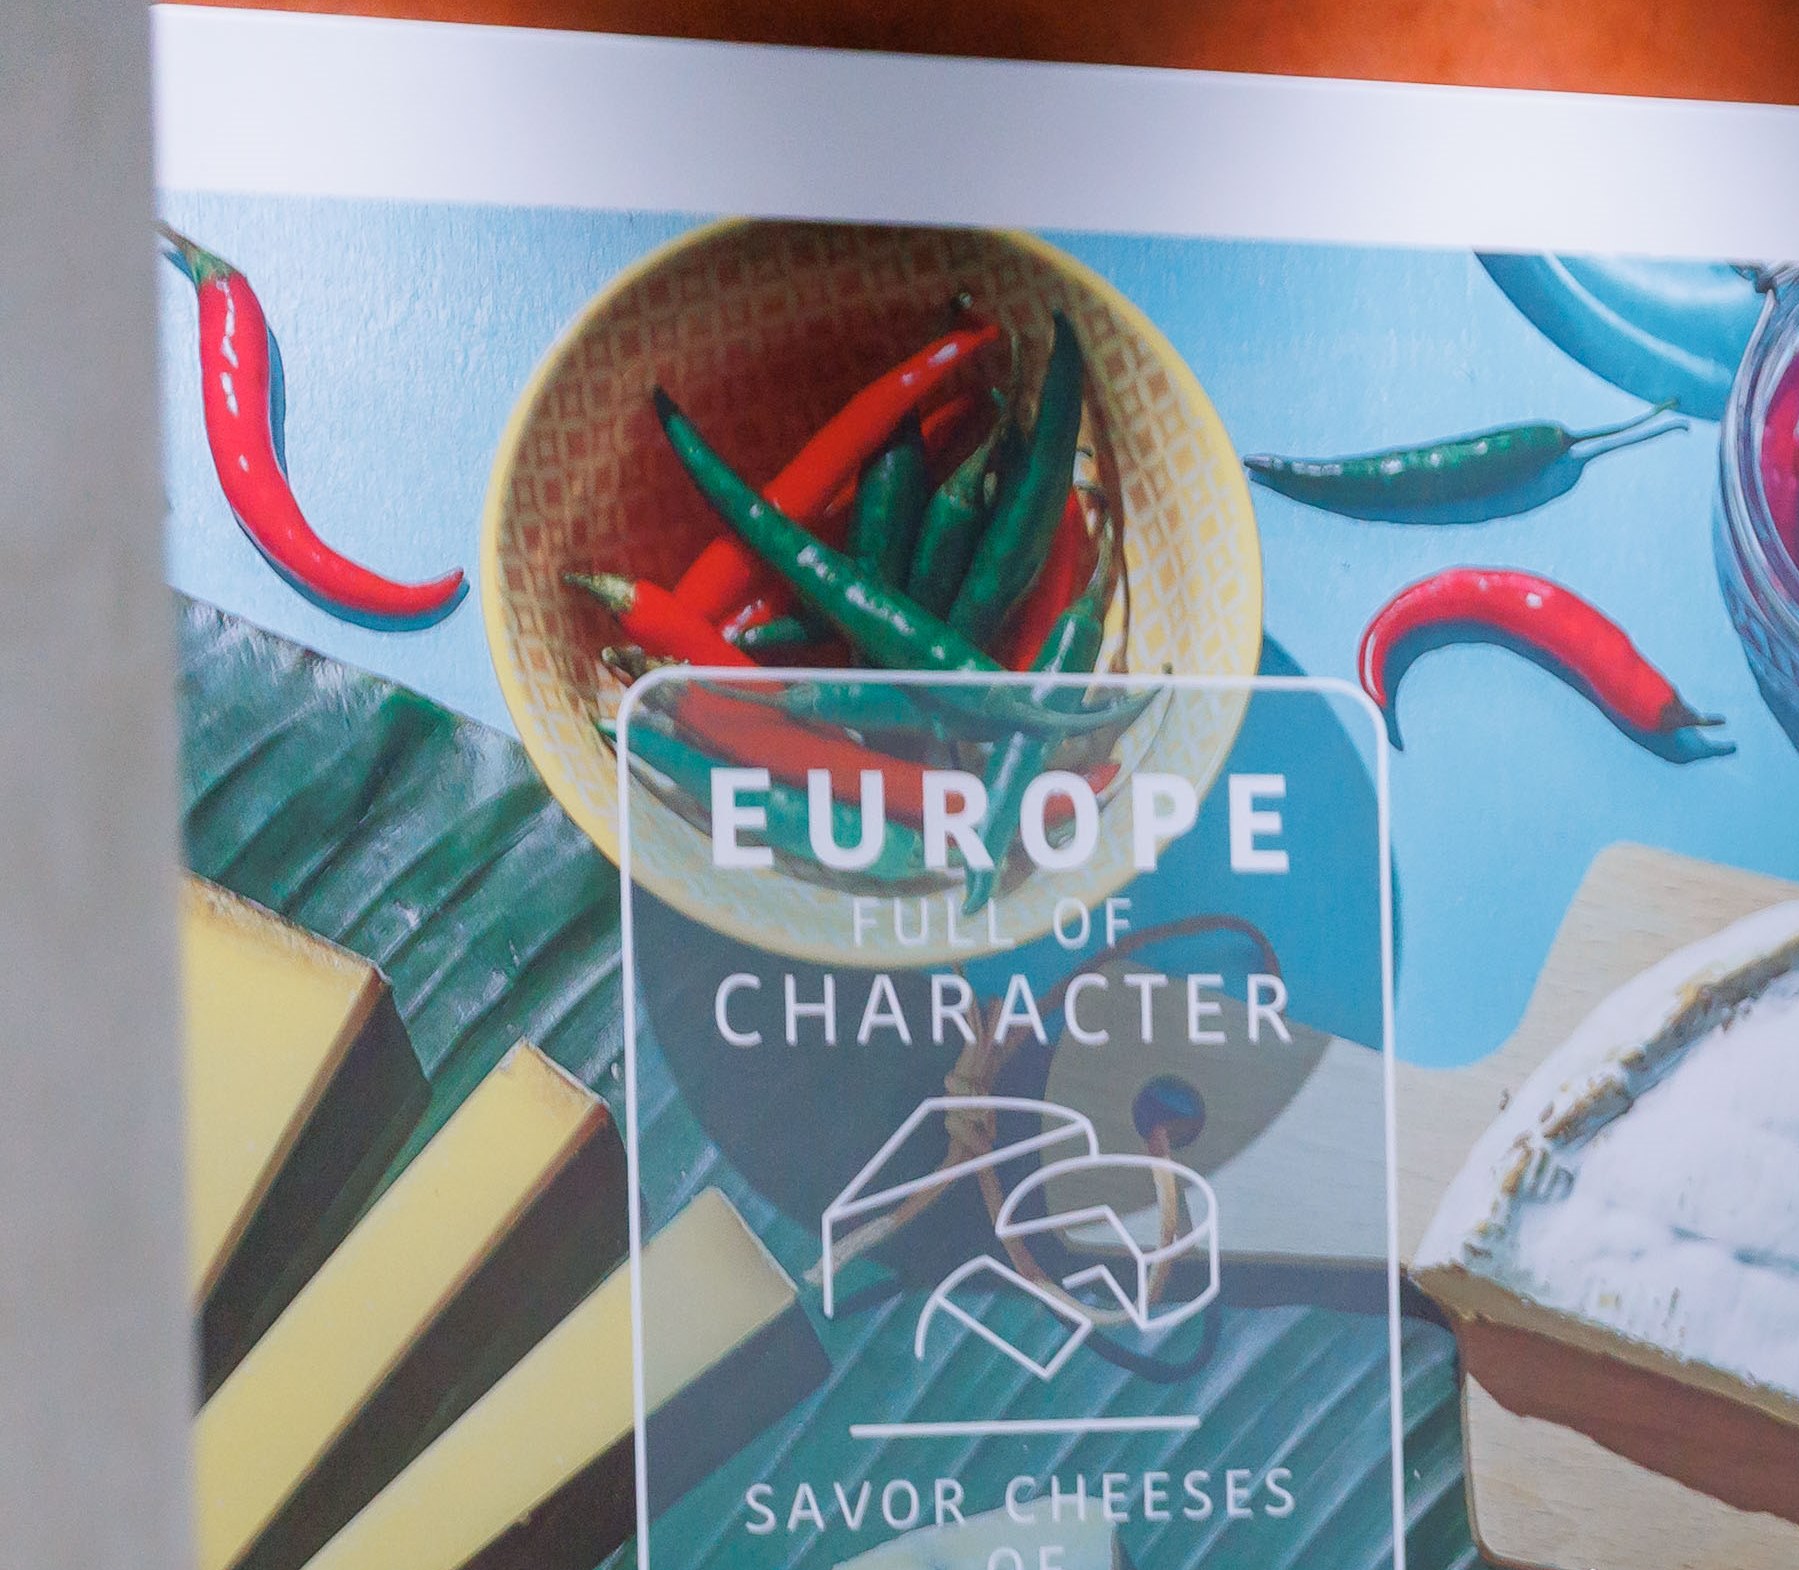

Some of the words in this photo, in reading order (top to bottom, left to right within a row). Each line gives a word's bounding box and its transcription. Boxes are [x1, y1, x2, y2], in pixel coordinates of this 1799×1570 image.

[709, 767, 1291, 874] EUROPE
[852, 895, 1016, 949] FULL
[1052, 897, 1133, 950] OF
[713, 972, 1295, 1048] CHARACTER
[744, 1478, 968, 1535] SAVOR
[1004, 1467, 1297, 1525] CHEESES
